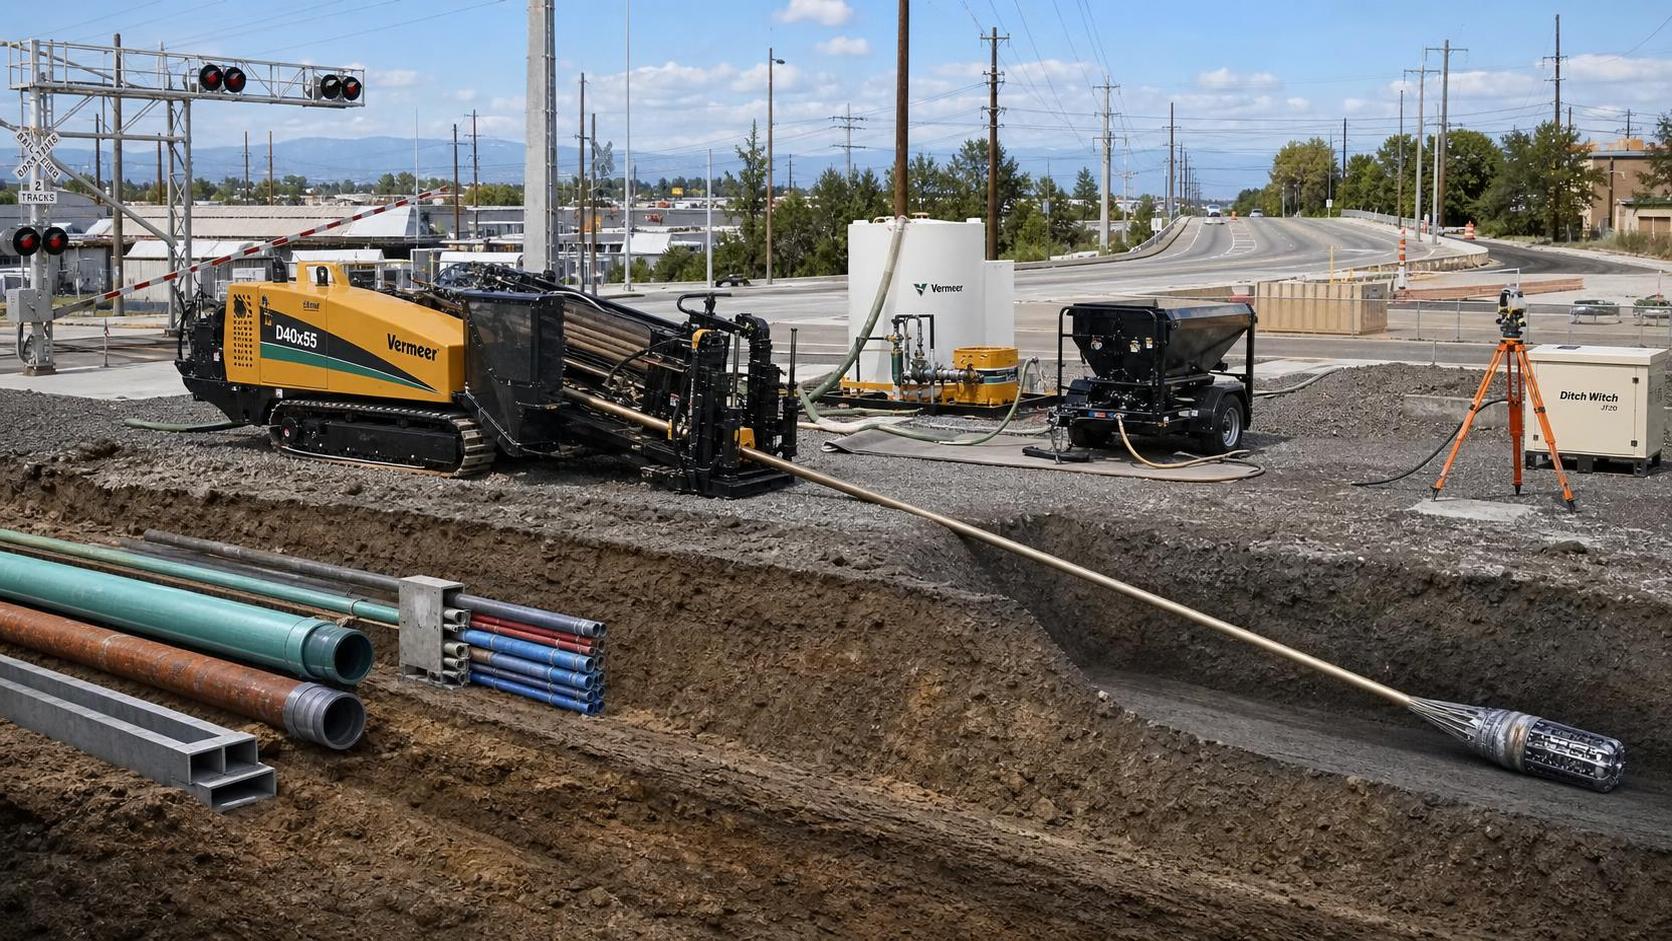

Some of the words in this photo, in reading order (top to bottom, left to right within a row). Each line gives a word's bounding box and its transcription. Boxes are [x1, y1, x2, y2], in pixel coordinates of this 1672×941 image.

[35, 181, 42, 191] 2
[22, 193, 54, 202] TRACKS
[931, 284, 963, 293] Vermeer
[276, 324, 317, 349] D40x55
[387, 333, 438, 361] Vermeer
[1560, 391, 1587, 401] Ditch
[1589, 392, 1618, 402] Witch
